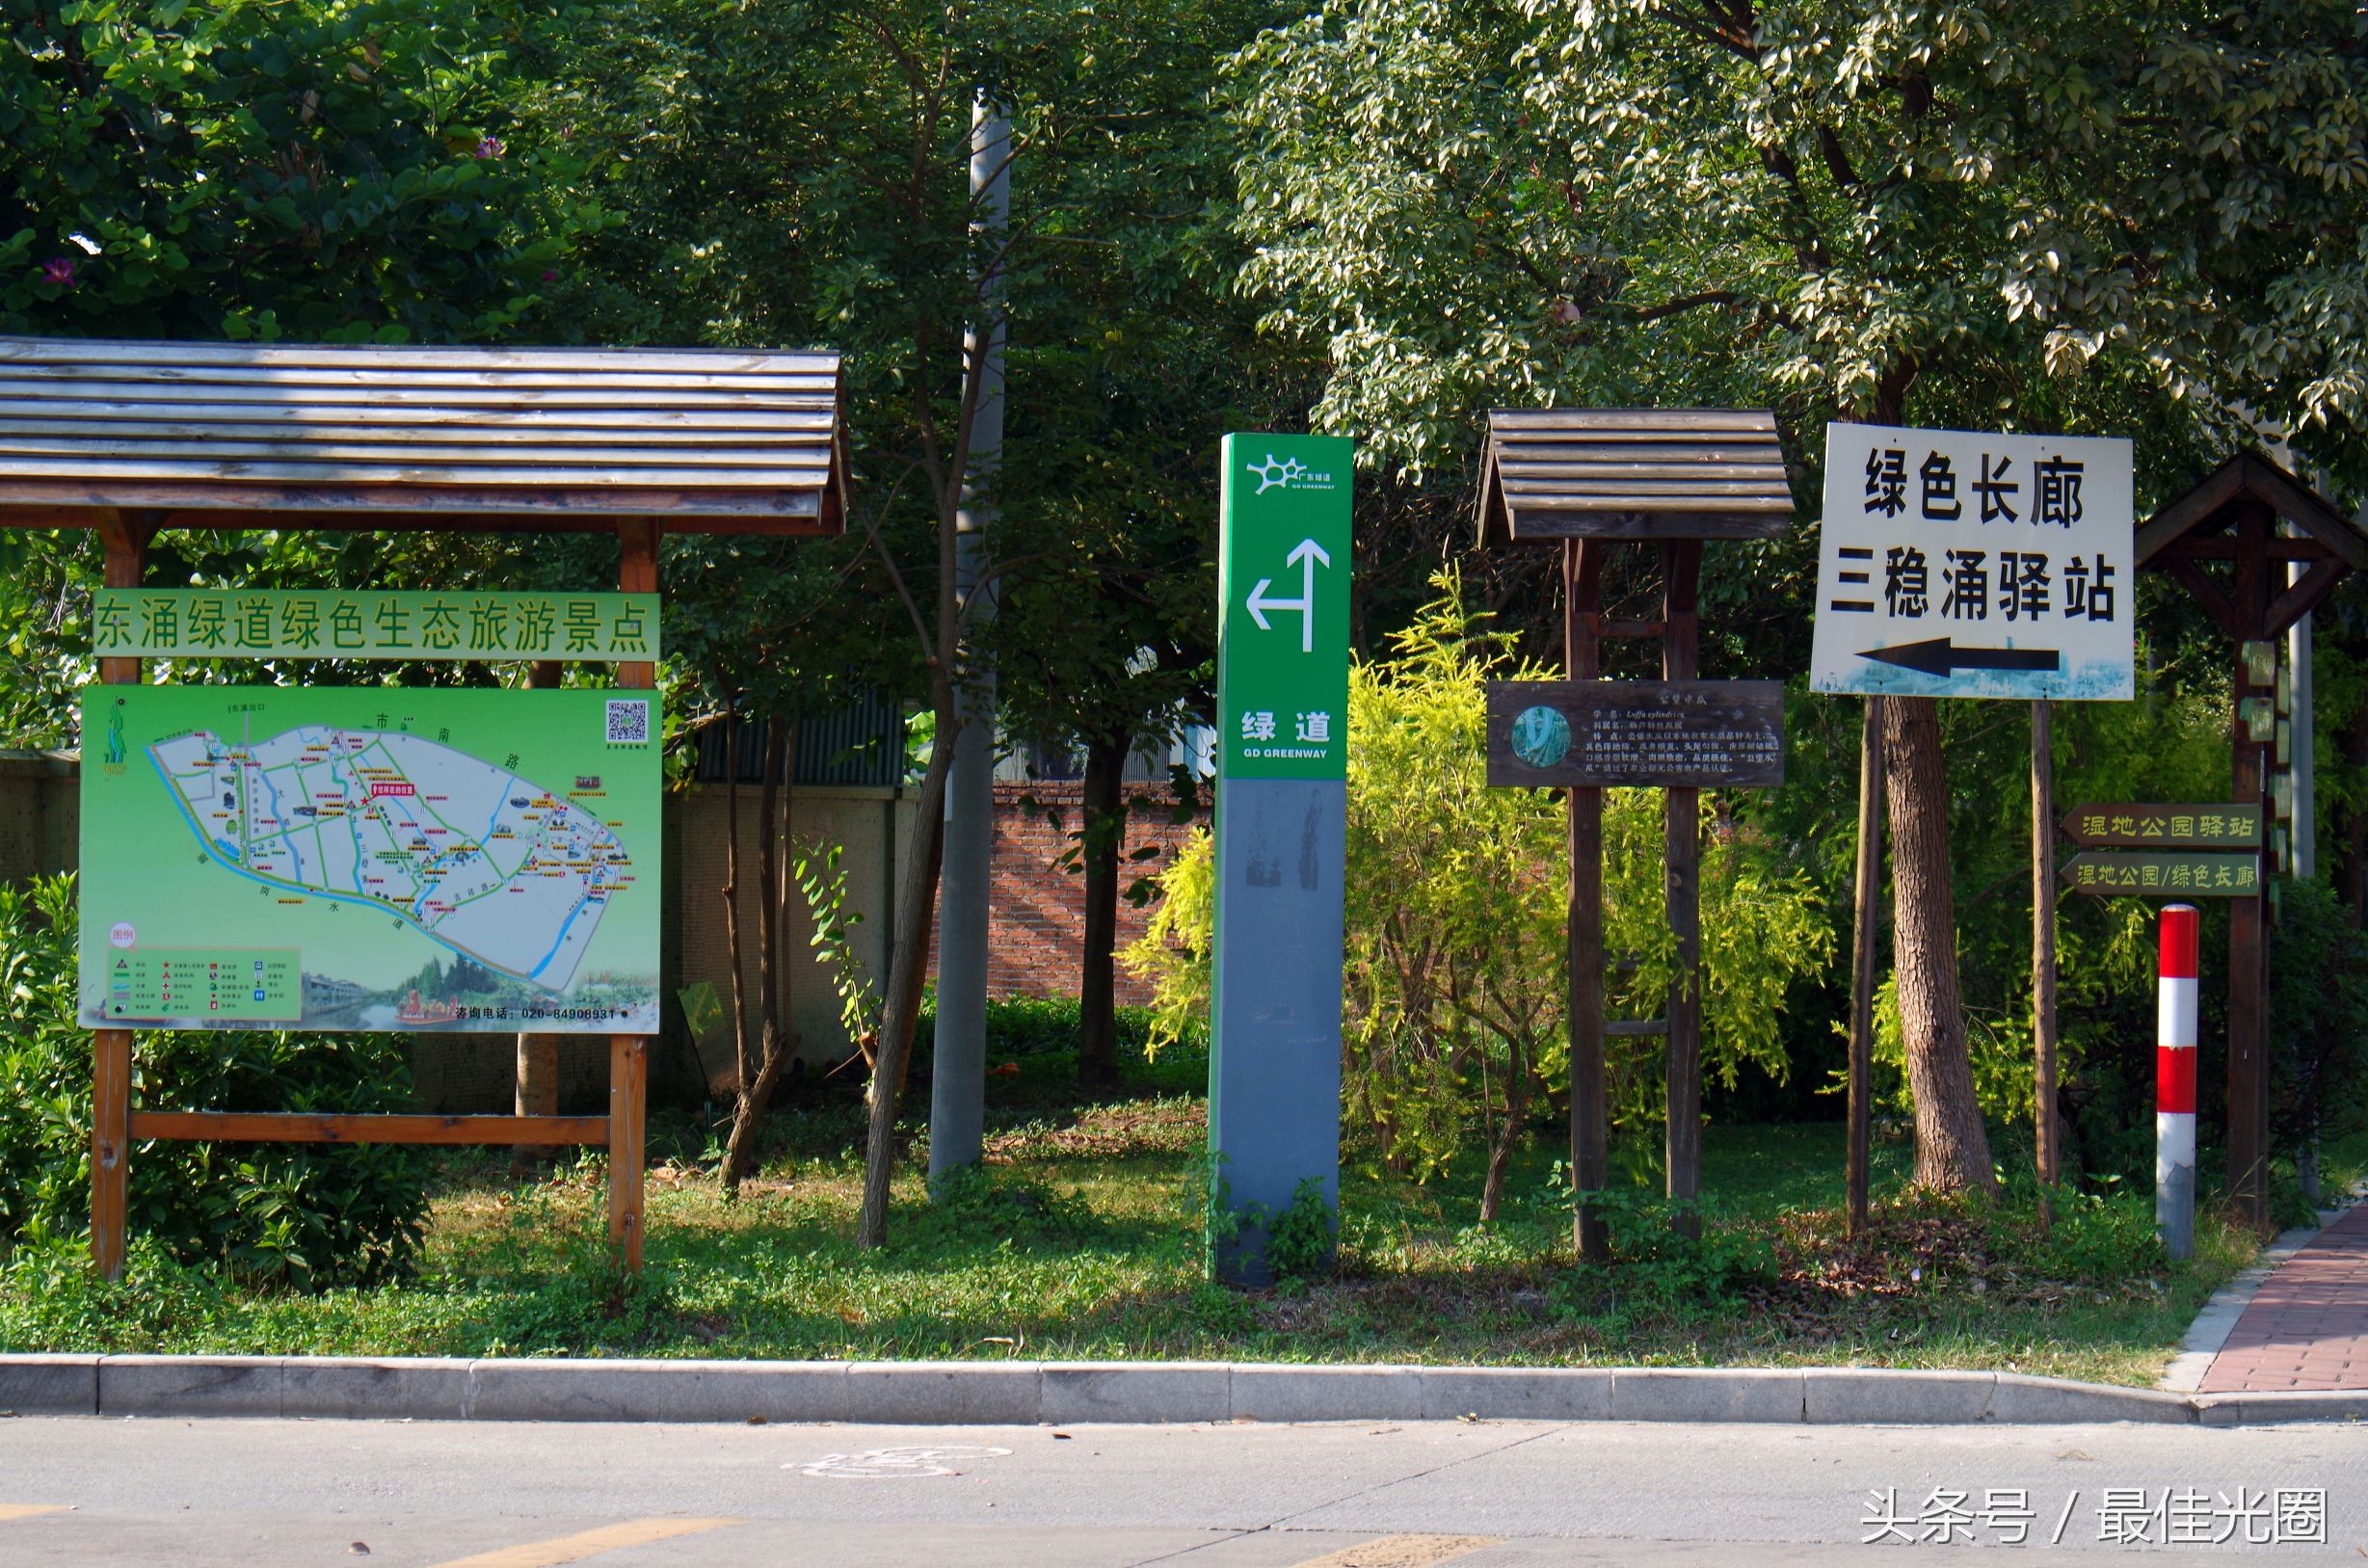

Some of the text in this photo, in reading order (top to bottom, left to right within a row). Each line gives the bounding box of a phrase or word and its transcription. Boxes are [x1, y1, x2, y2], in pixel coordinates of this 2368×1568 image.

[1864, 447, 2085, 528] 绿色长廊
[1830, 545, 2115, 622] 三稳涌驿站
[95, 596, 649, 654] 东涌绿道绿色生态旅游景点
[1241, 711, 1331, 743] 绿道
[1243, 748, 1327, 759] GD GREENWAY
[2083, 815, 2254, 837] 湿地公园驿站
[2078, 864, 2254, 888] 湿地公园/绿色长廊
[112, 929, 134, 941] 图例
